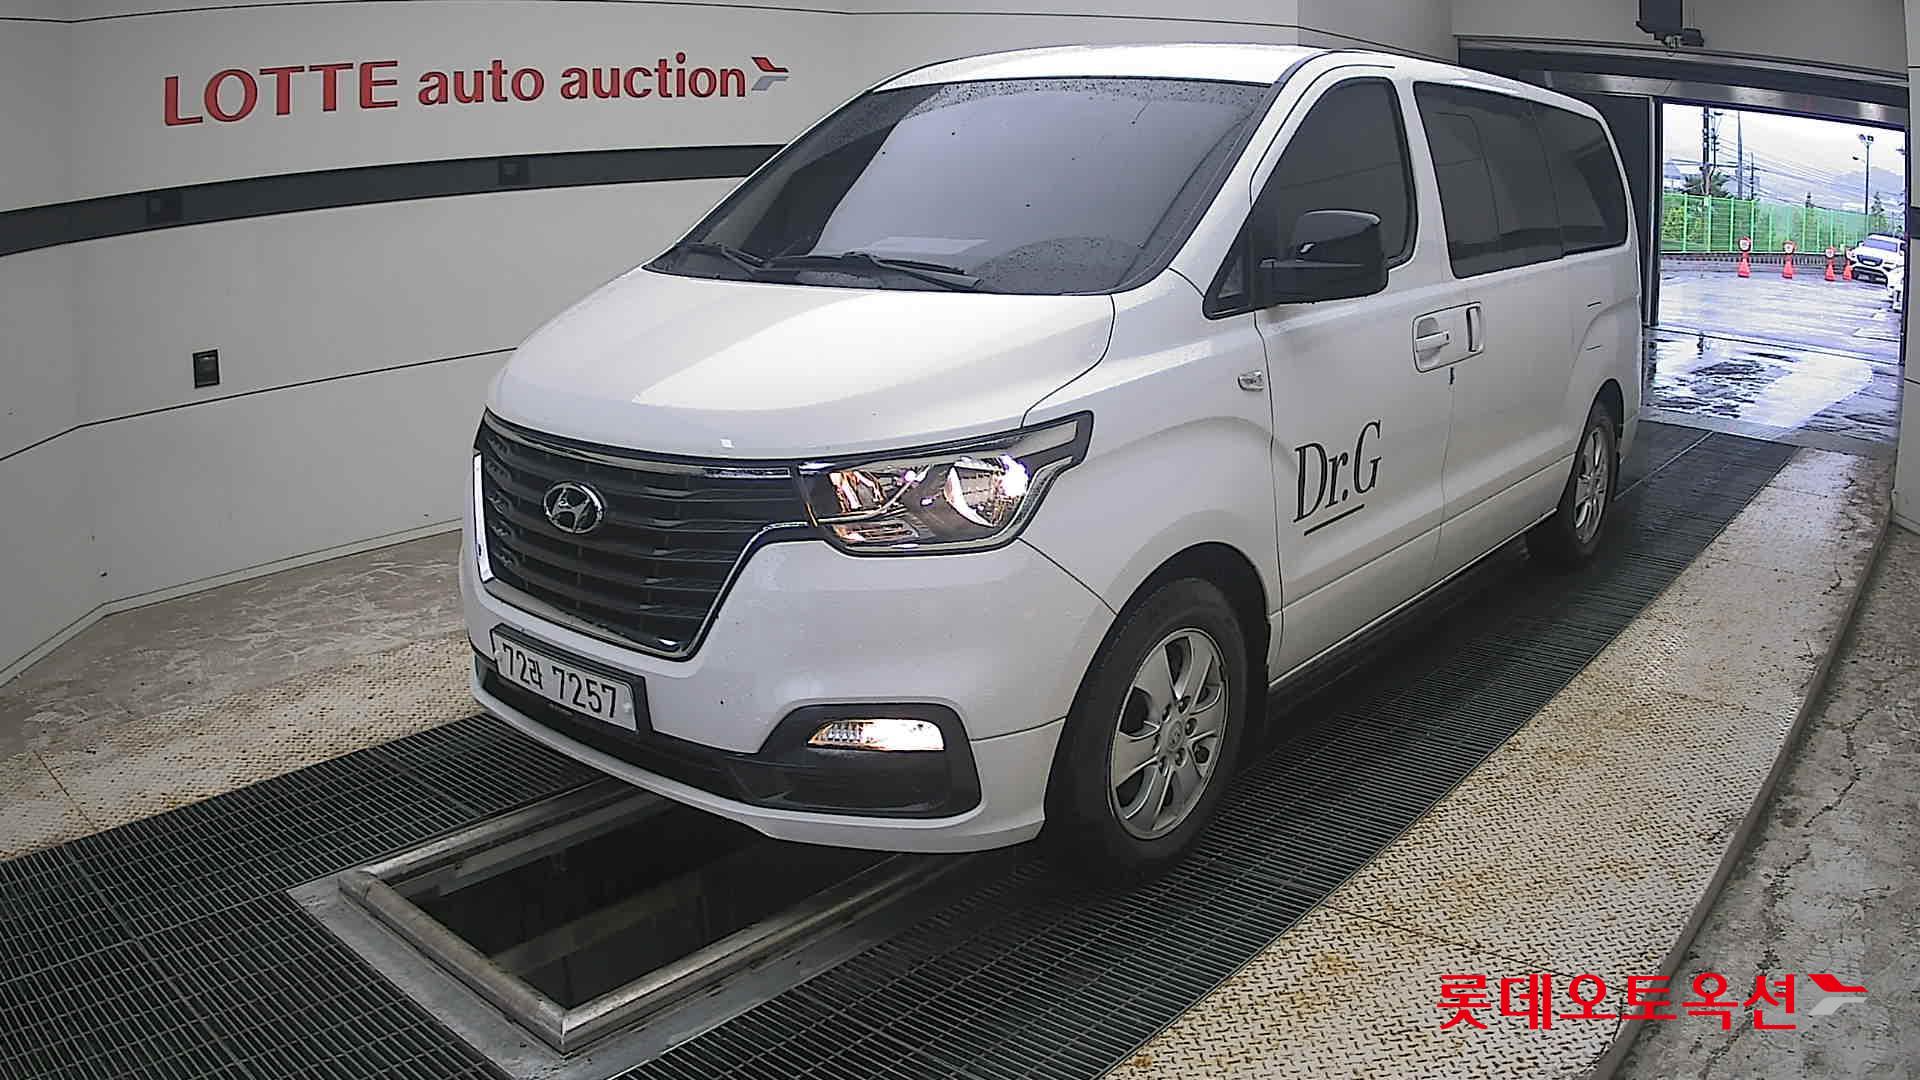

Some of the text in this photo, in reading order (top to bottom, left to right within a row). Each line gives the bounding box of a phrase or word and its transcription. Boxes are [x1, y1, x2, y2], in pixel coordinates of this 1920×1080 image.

[164, 52, 746, 126] LOTTE auto auction
[1293, 419, 1382, 523] Dr.G
[503, 643, 616, 718] 72라 7257
